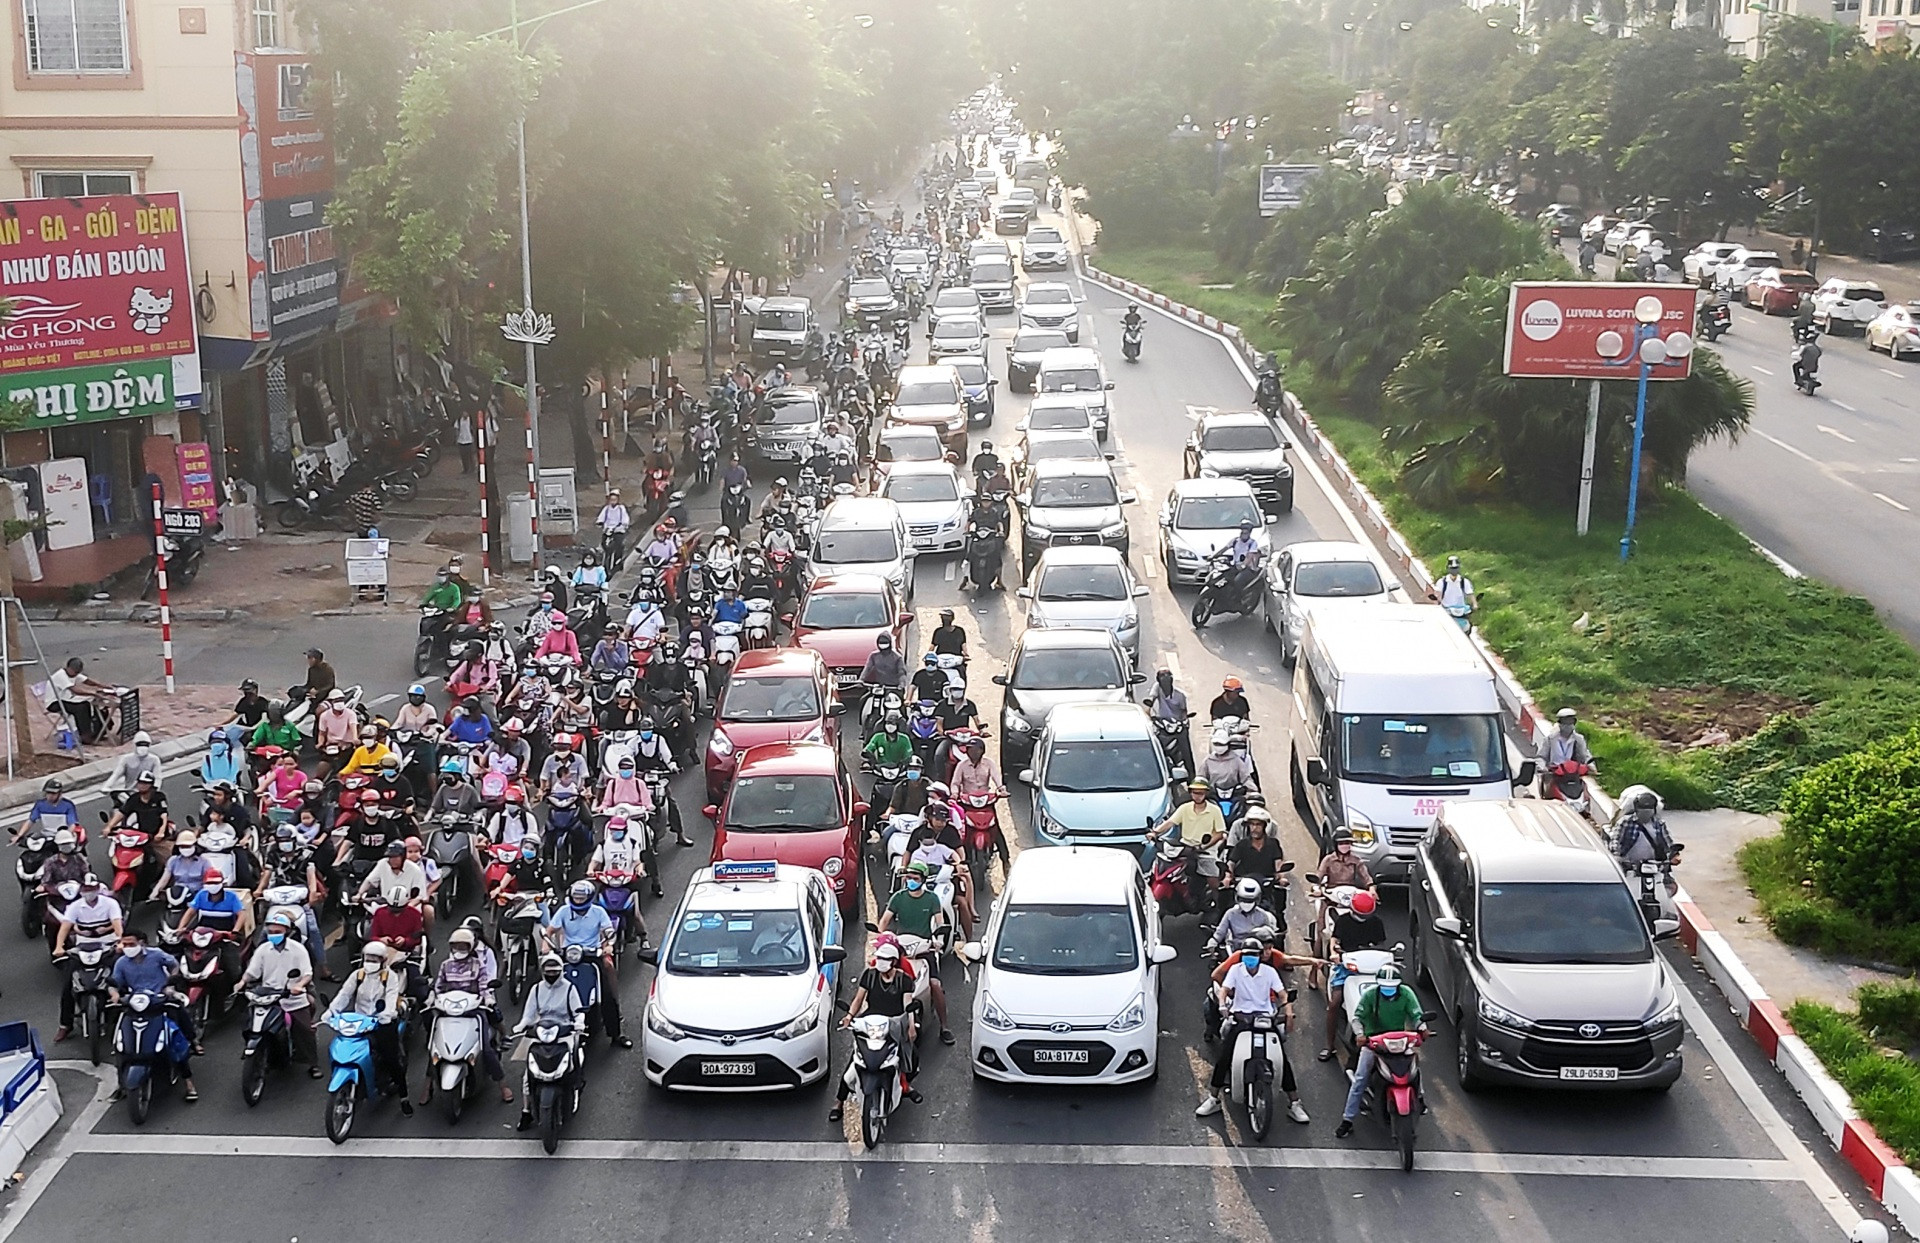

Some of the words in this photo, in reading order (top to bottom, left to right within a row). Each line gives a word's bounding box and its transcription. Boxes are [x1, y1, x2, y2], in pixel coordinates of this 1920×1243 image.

[40, 214, 68, 242] GA
[85, 202, 119, 239] GỐI
[135, 203, 178, 239] ĐỆM
[2, 254, 51, 285] NHƯ
[56, 249, 102, 280] BÁN
[107, 244, 166, 276] BUÔN
[33, 315, 116, 337] HONG
[1663, 311, 1684, 320] JSC
[86, 368, 166, 415] ĐỆM
[184, 514, 200, 528] 203
